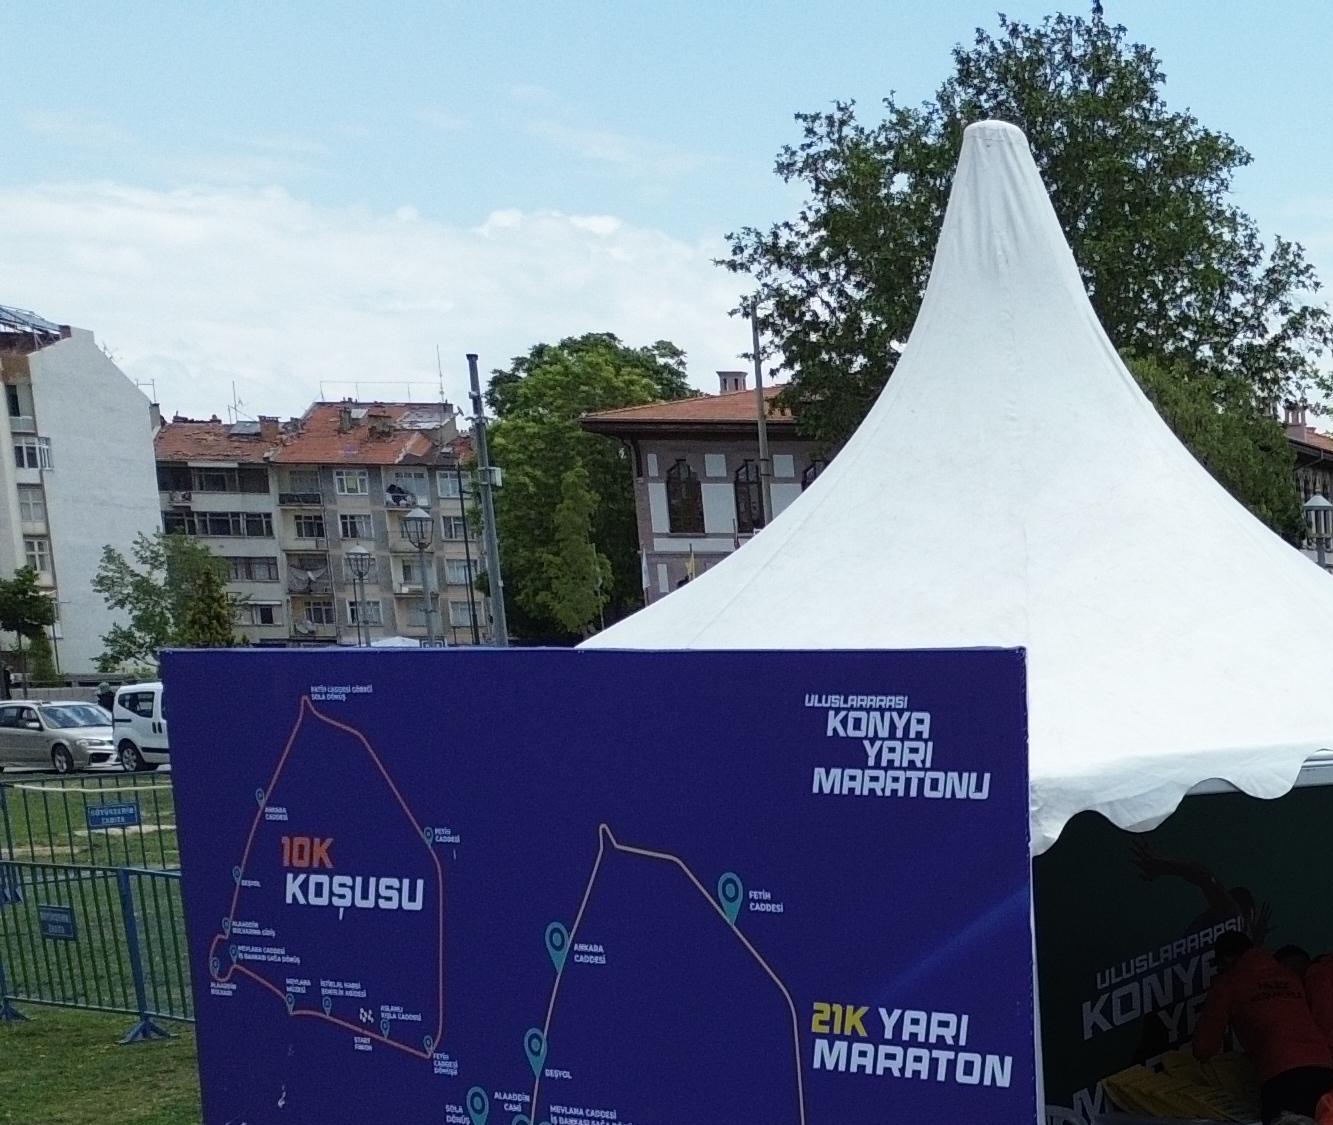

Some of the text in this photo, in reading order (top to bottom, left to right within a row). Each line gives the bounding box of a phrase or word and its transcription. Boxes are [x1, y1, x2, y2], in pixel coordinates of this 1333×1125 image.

[804, 694, 909, 709] ULUSLARARASI
[826, 710, 931, 739] KONYA
[862, 739, 934, 769] YARI
[812, 767, 991, 801] MARATONU
[280, 836, 335, 869] 10K
[285, 872, 425, 920] KOŞUSU
[811, 1001, 970, 1046] 21K YARI
[813, 1038, 1012, 1088] MARATON
